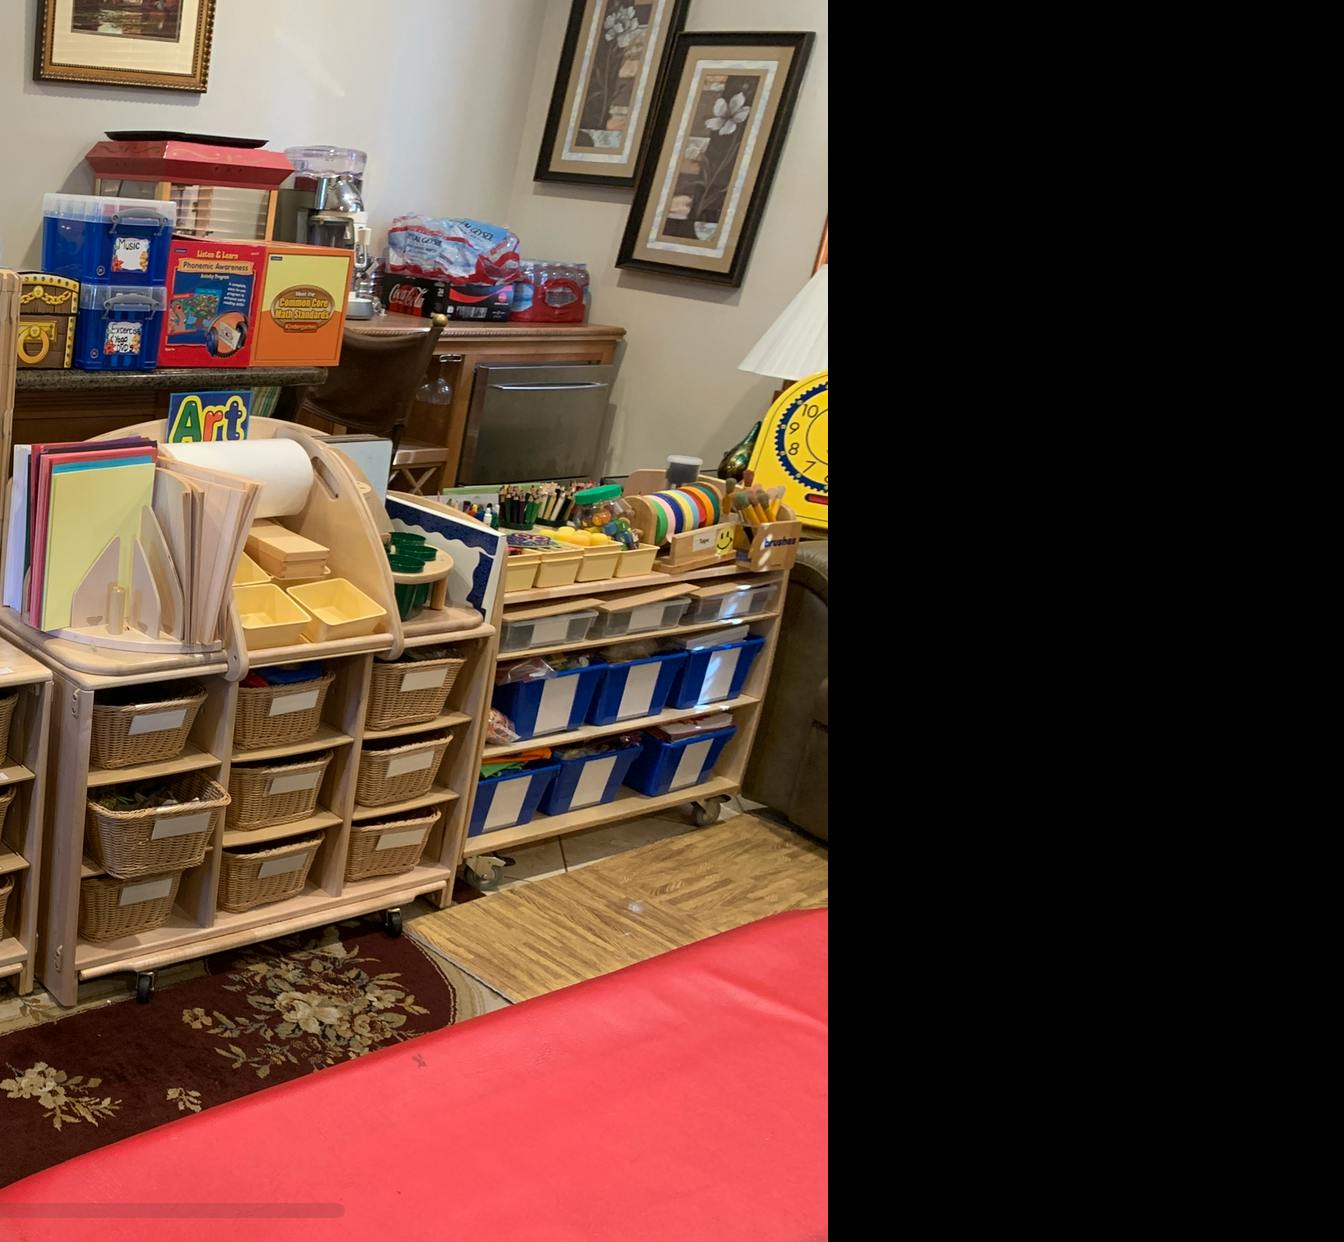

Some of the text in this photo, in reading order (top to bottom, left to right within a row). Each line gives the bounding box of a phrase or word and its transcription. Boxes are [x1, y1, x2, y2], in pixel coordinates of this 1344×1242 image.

[183, 261, 249, 271] Phonemic Awareness
[279, 298, 328, 308] Common Core
[276, 309, 329, 320] Math Standards
[802, 404, 819, 418] 10
[172, 400, 243, 442] Art
[789, 422, 800, 435] 9
[788, 442, 800, 456] 8
[803, 460, 817, 473] 7
